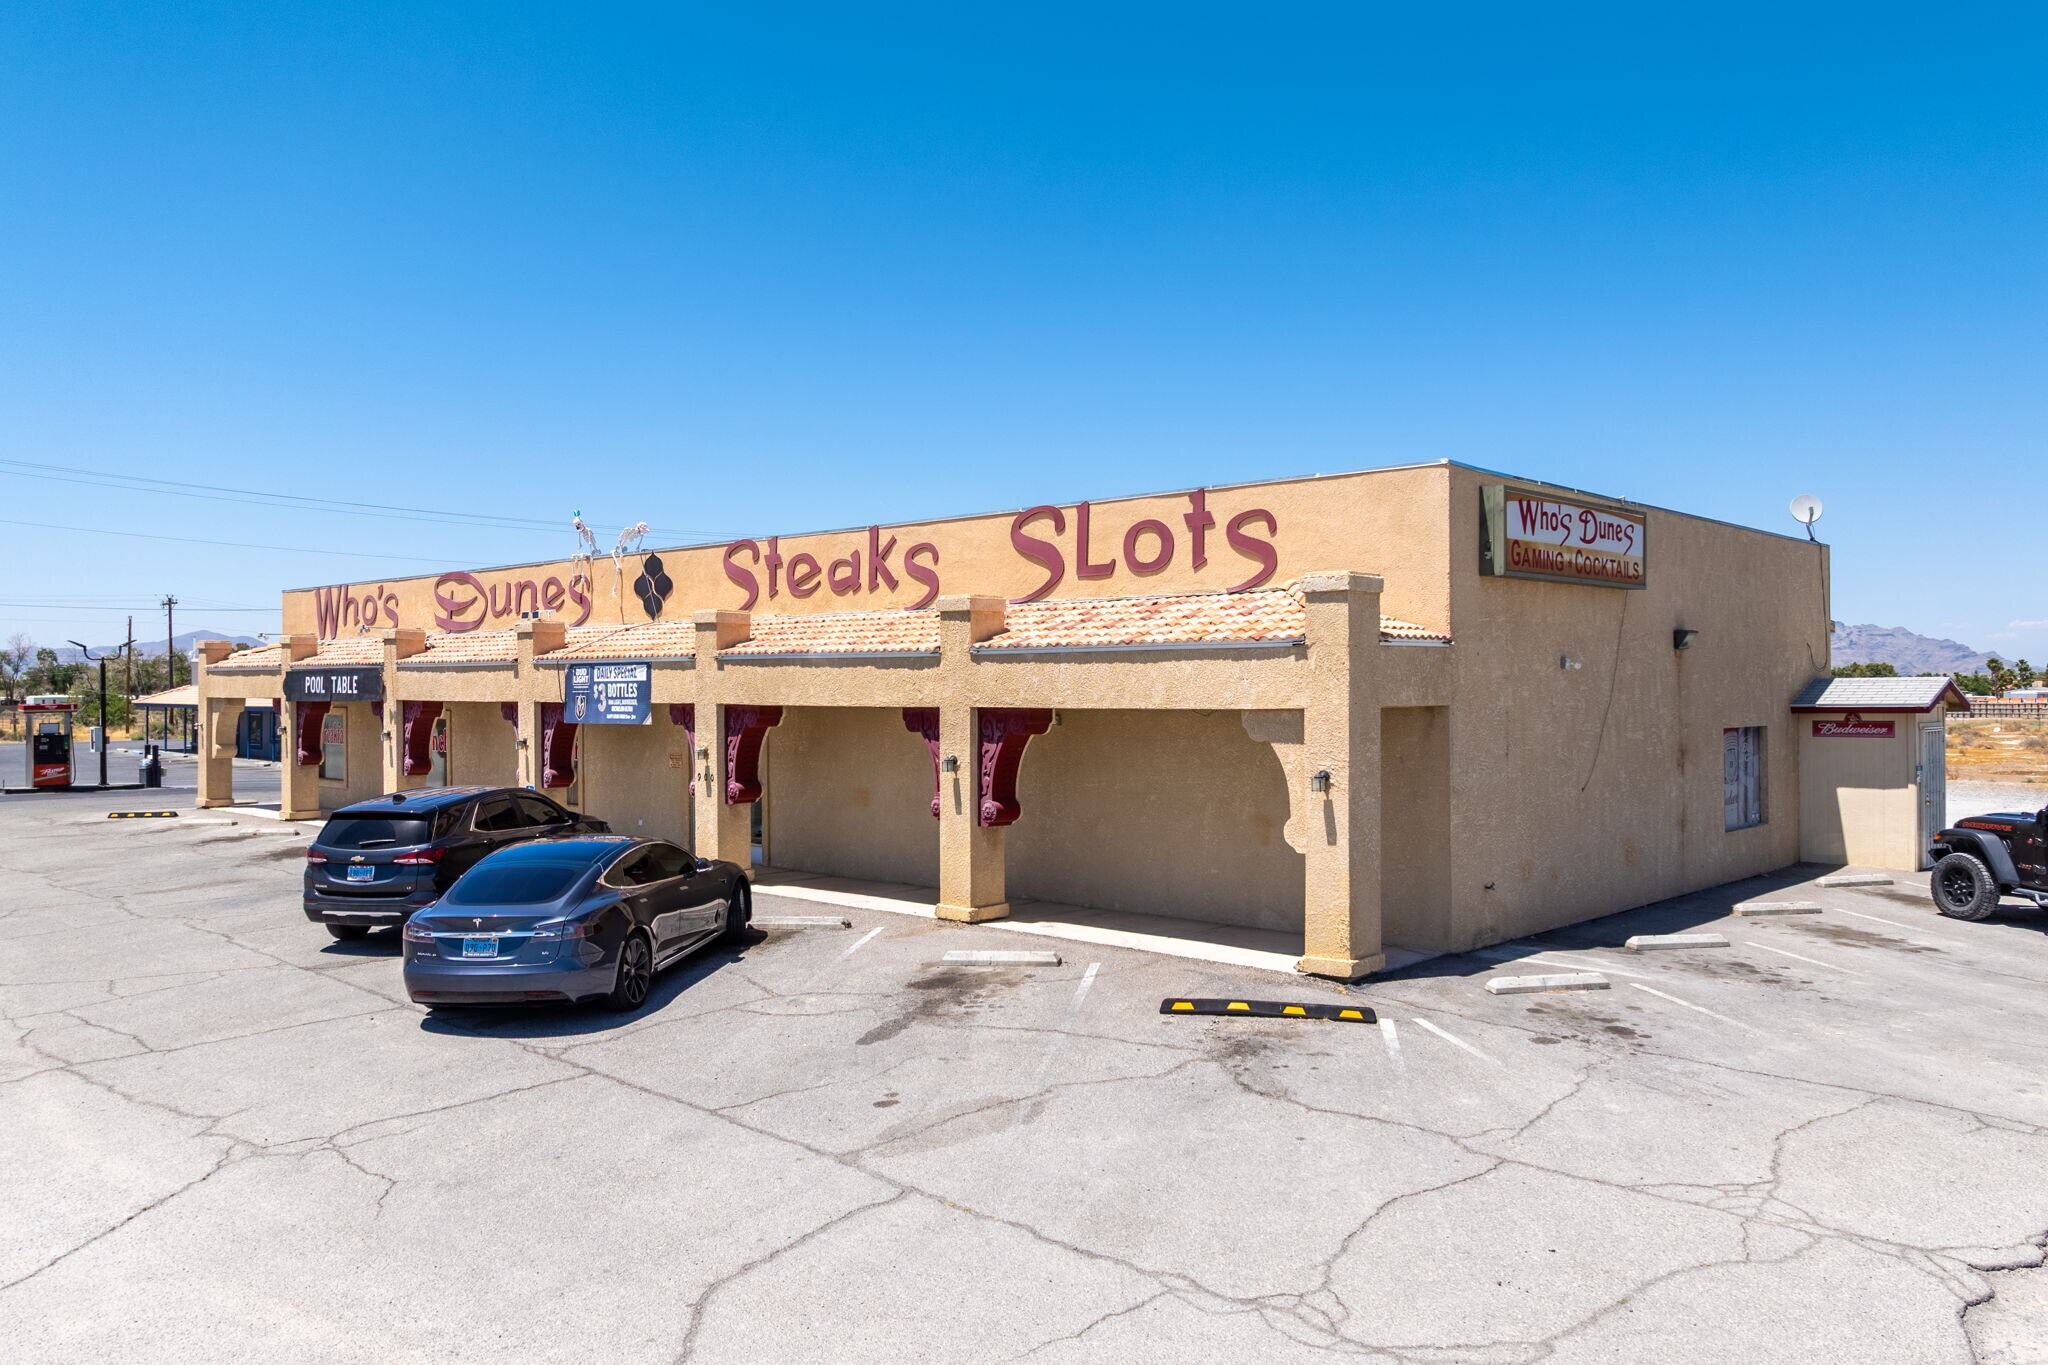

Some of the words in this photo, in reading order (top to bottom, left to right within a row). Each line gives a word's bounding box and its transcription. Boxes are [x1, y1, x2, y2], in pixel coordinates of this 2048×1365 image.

[1518, 498, 1572, 547] Who's
[1579, 509, 1635, 556] Dunes
[1511, 540, 1564, 571] GAMING
[1575, 549, 1640, 580] COCKTAILS
[315, 584, 399, 640] Who's
[434, 571, 591, 634] Dunes
[723, 525, 940, 611] Steaks
[573, 675, 589, 683] LIGHT
[596, 667, 612, 679] DAILY
[305, 676, 325, 693] POOL
[331, 675, 358, 694] TABLE
[607, 683, 638, 697] BOTTLES
[1818, 722, 1889, 735] Budweiser
